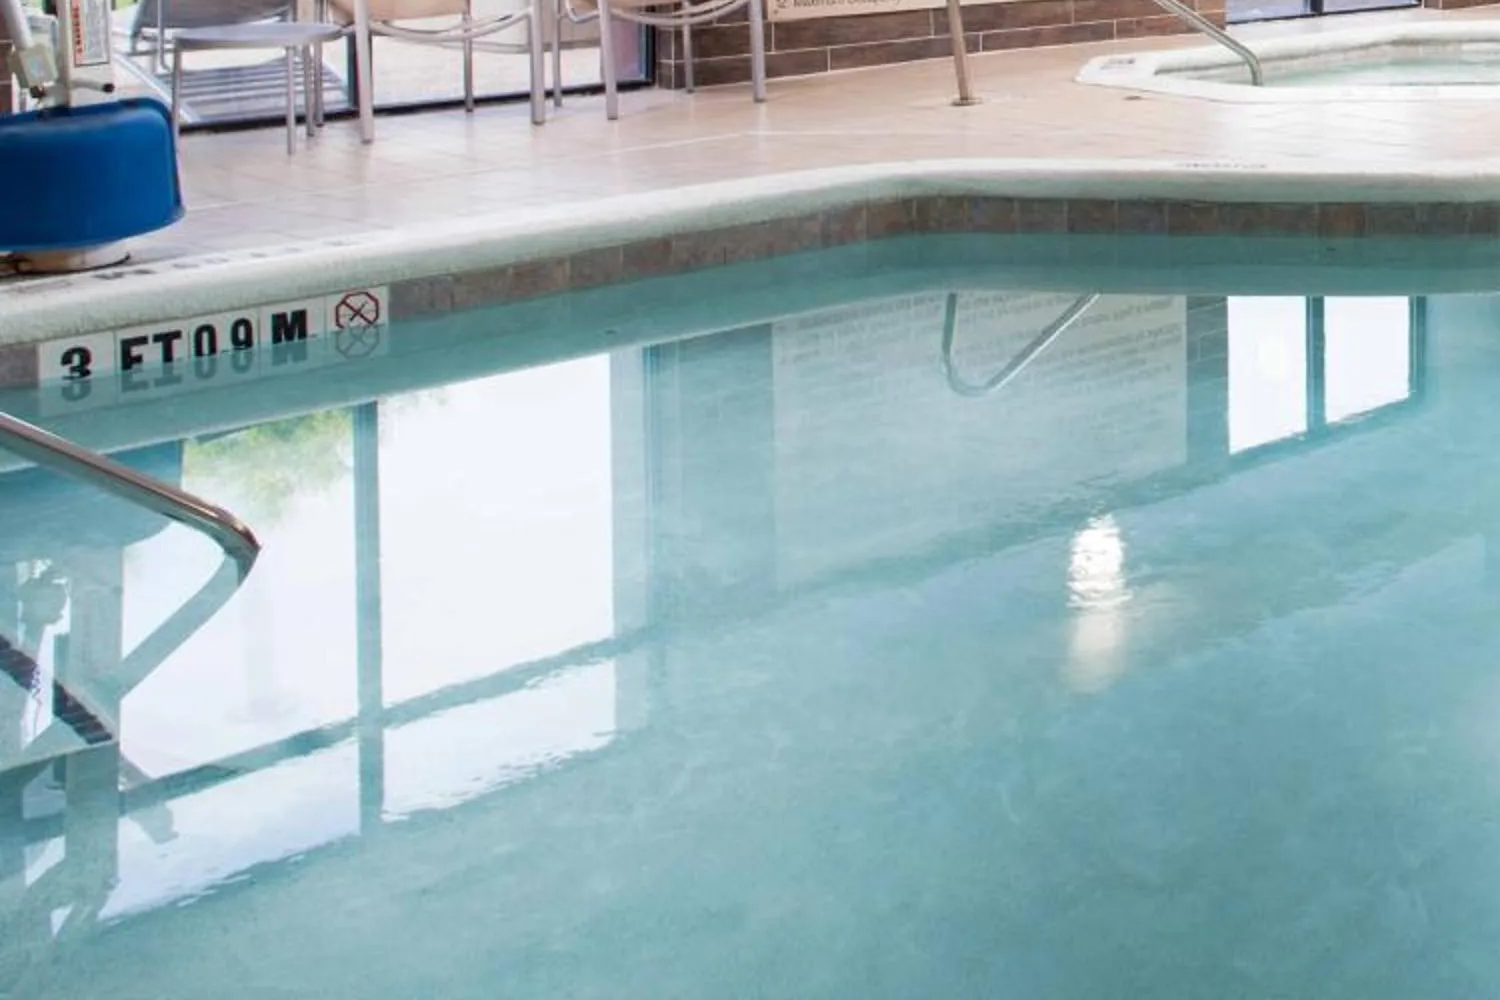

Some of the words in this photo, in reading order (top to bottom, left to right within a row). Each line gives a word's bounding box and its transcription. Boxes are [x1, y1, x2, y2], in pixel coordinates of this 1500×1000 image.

[61, 346, 92, 381] 3
[121, 330, 182, 371] FT
[272, 309, 307, 345] M
